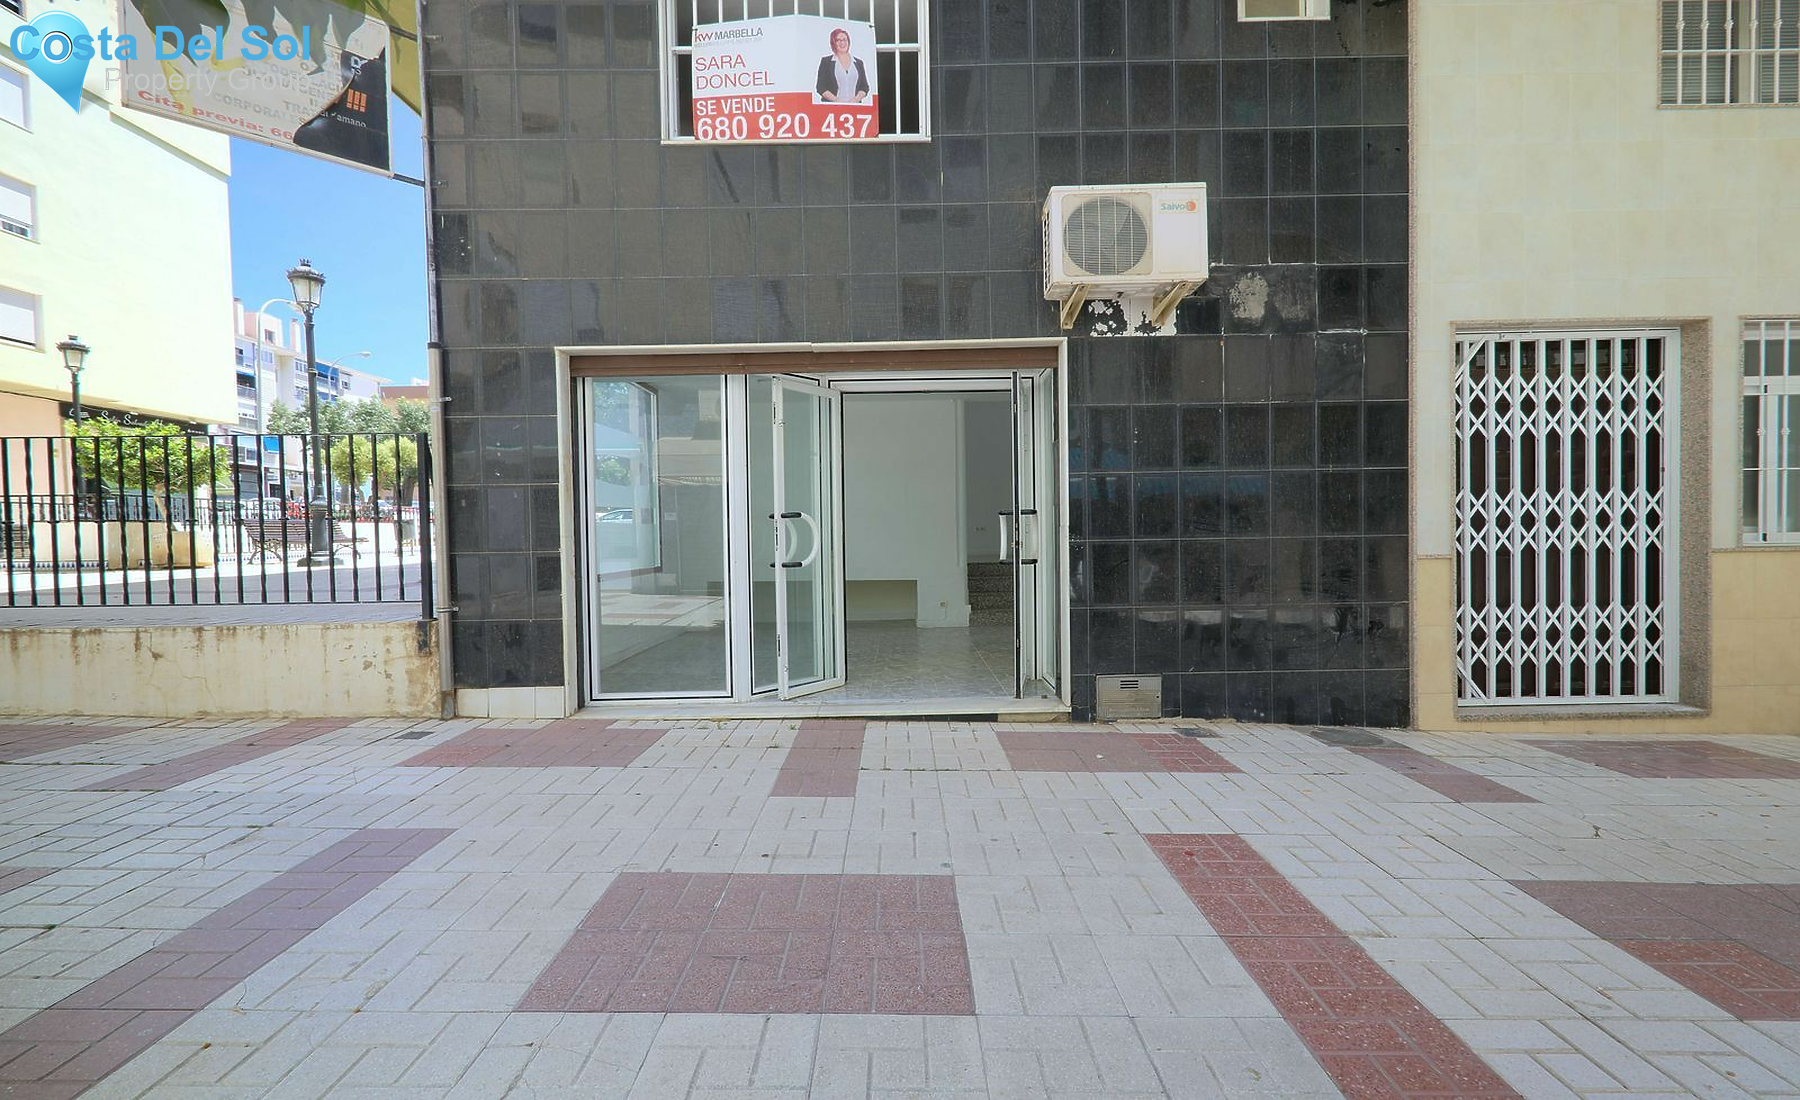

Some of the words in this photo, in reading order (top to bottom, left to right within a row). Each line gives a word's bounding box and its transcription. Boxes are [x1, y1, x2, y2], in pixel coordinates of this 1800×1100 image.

[715, 27, 763, 40] MARBELLA
[695, 54, 746, 71] SARA
[696, 71, 775, 89] DONCEL
[137, 90, 185, 111] Cita
[192, 107, 264, 132] previa:
[696, 99, 717, 116] SE
[721, 96, 775, 114] VENDE
[697, 115, 748, 140] 680
[758, 113, 811, 138] 920
[821, 113, 873, 138] 437
